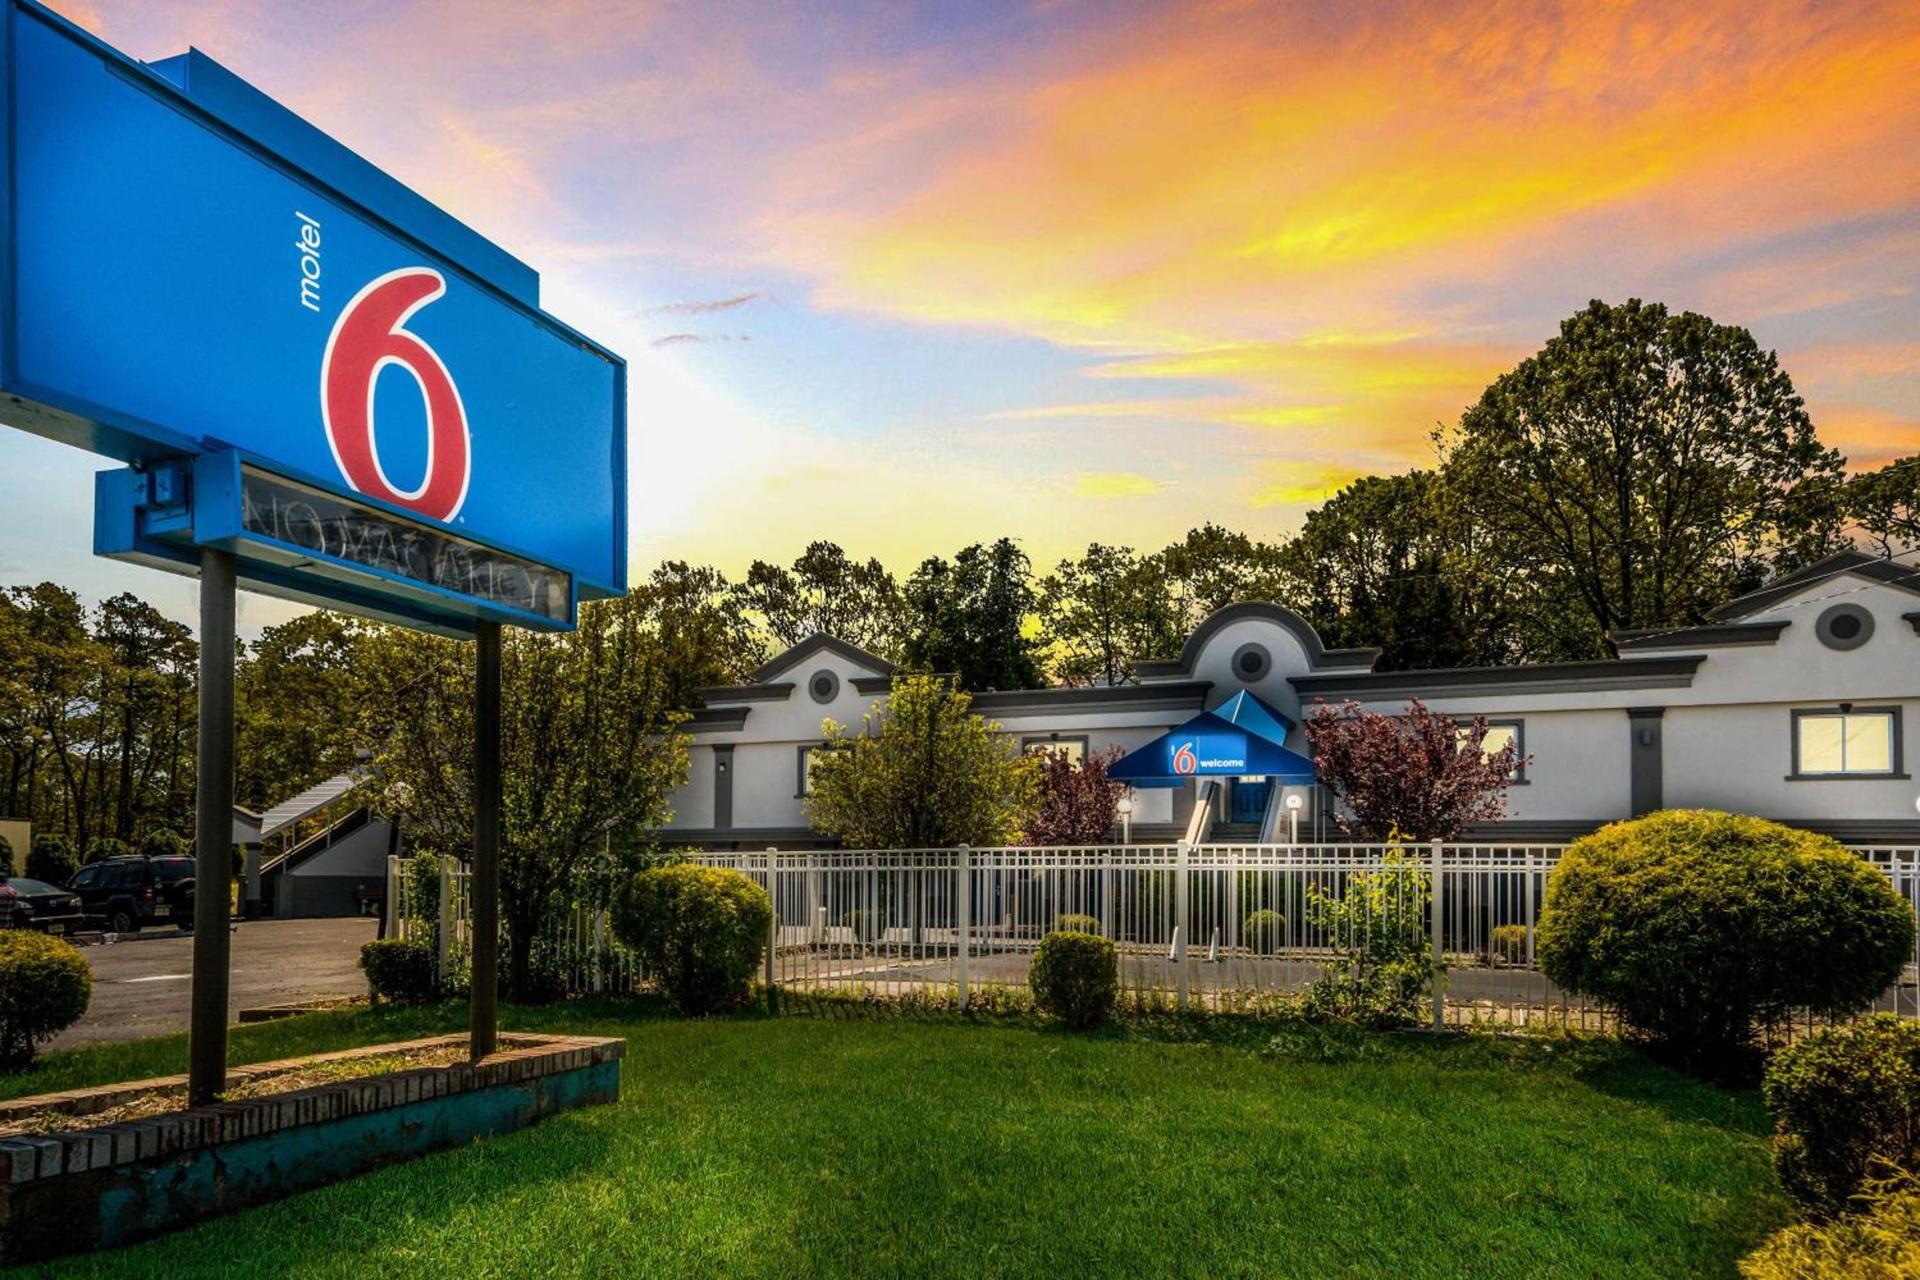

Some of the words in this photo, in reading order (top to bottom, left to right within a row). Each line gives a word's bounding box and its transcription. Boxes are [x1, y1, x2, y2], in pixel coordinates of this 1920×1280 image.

[295, 211, 321, 312] motel
[320, 266, 471, 523] 6
[245, 487, 326, 555] NO
[338, 515, 546, 609] VACANCY
[1173, 742, 1197, 775] 6
[1200, 758, 1244, 768] welcome
